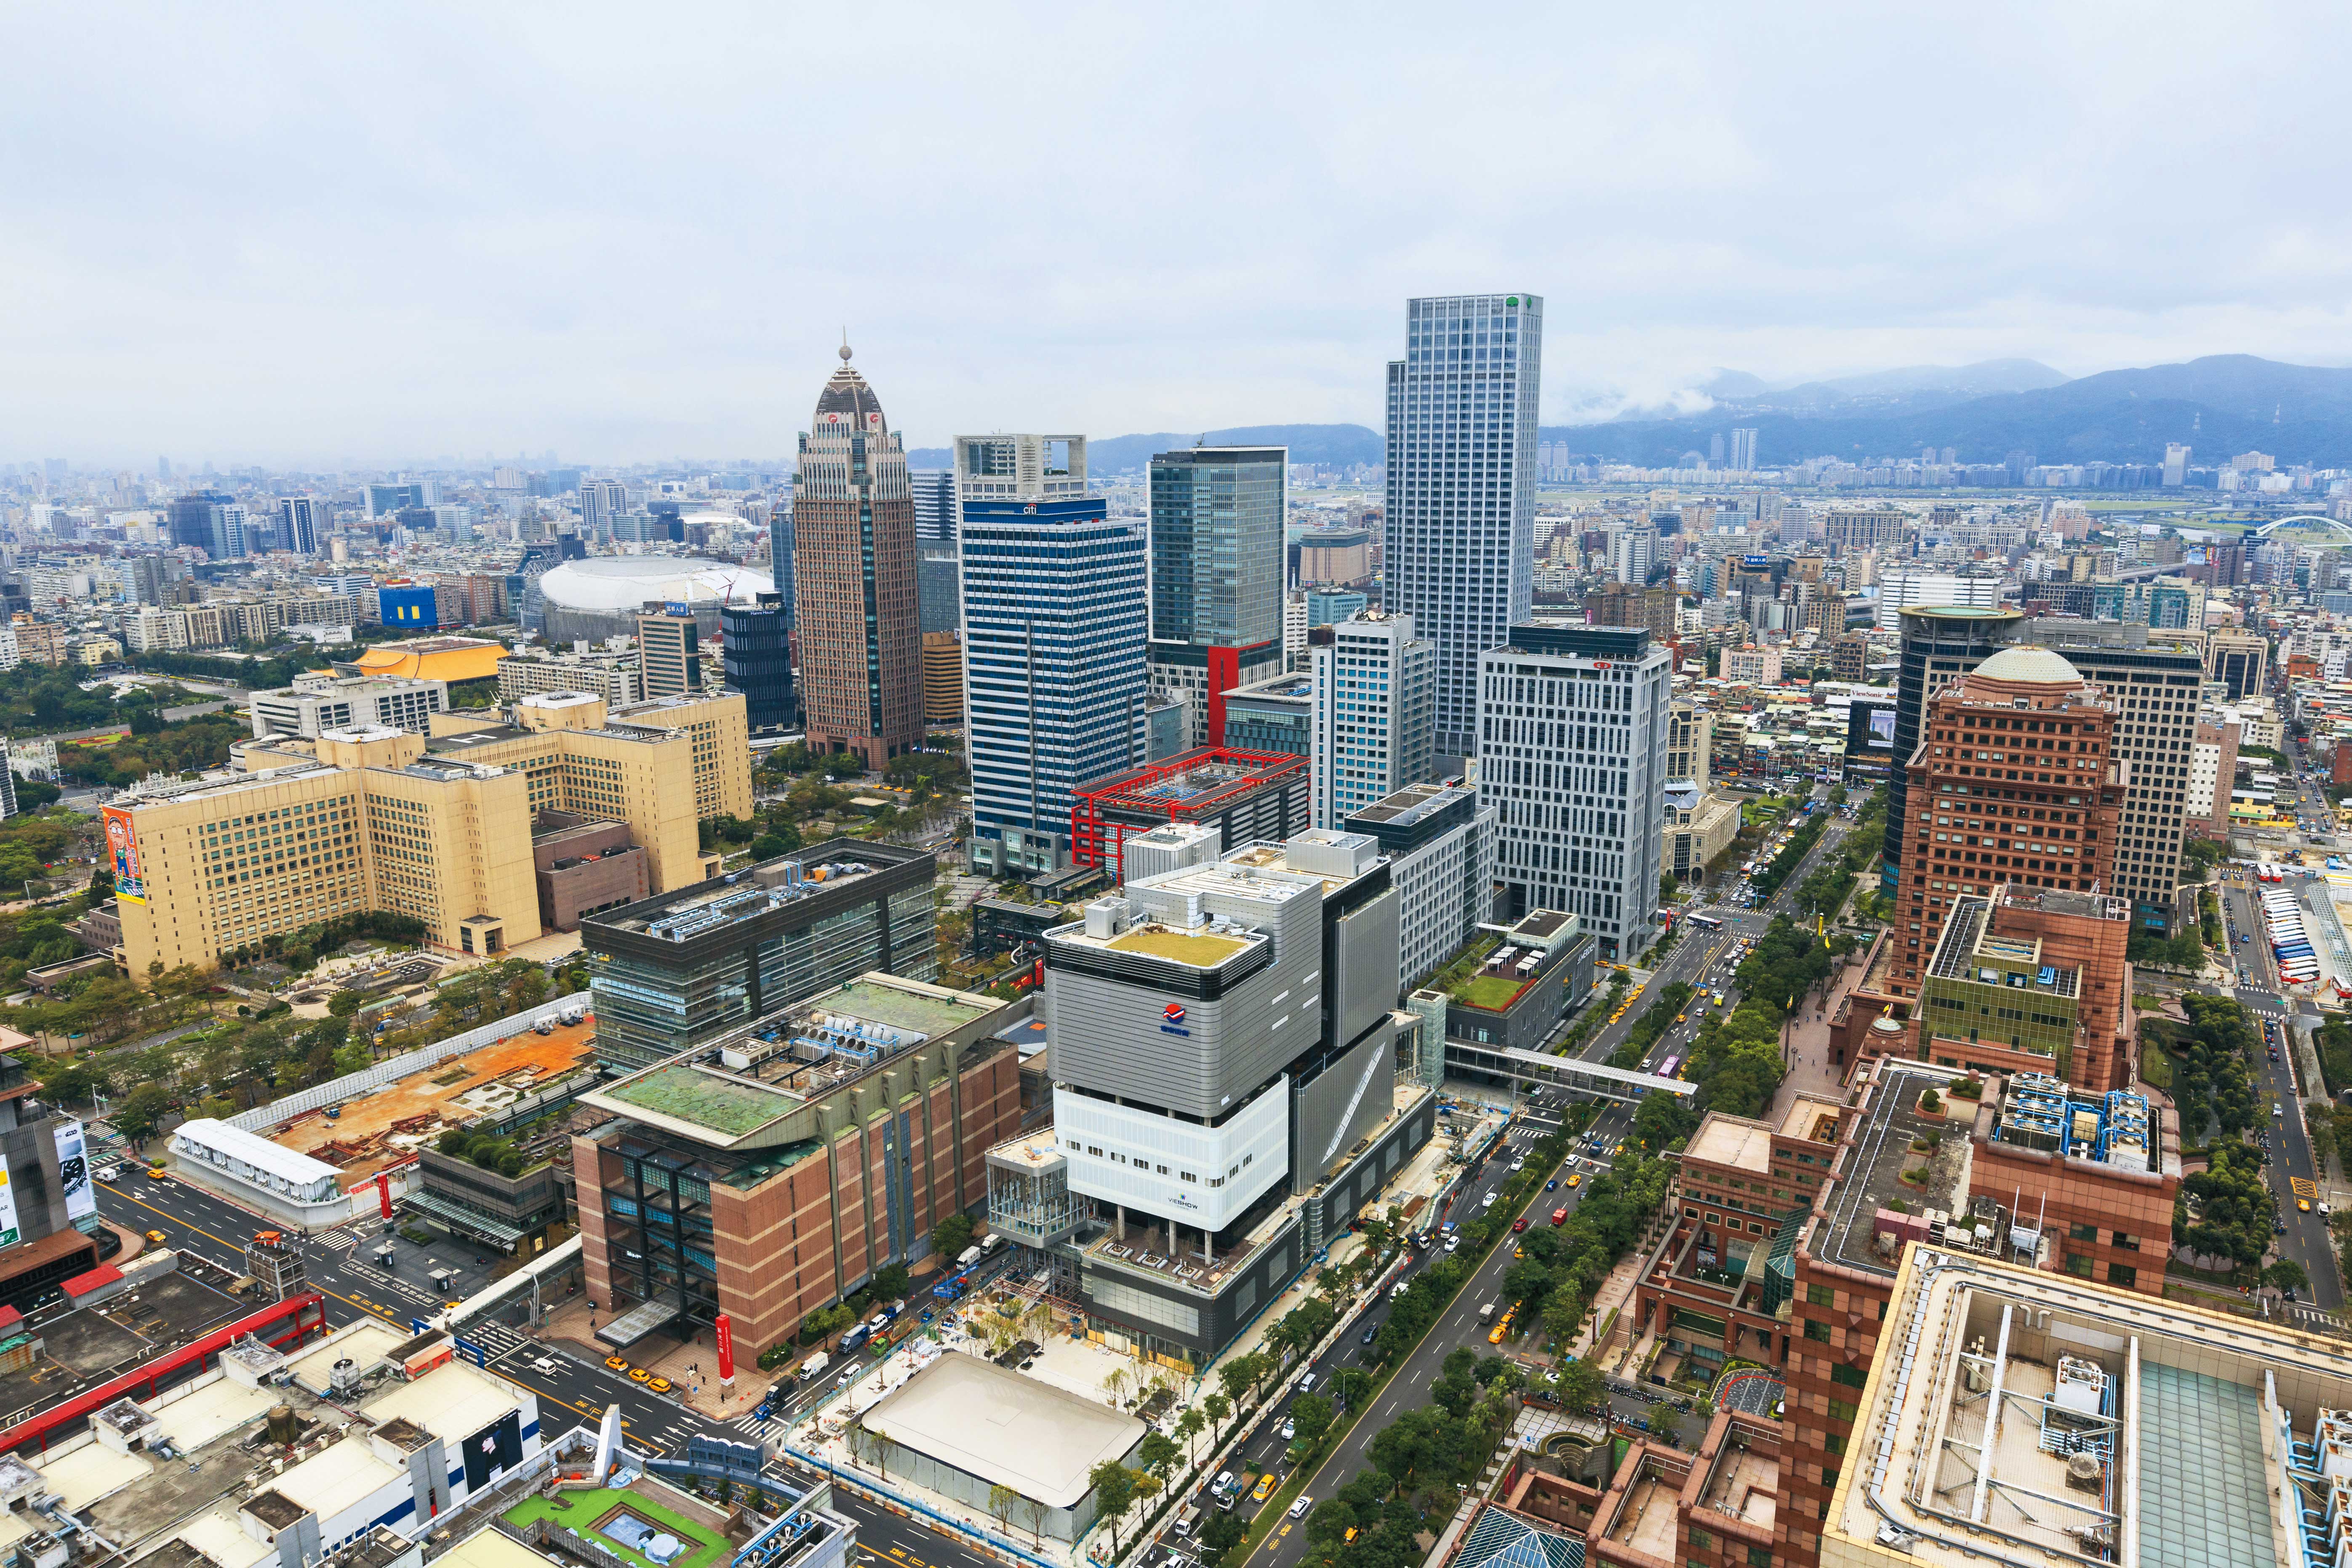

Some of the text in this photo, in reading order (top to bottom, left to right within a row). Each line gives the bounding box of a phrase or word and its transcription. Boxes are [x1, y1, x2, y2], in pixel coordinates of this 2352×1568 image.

[1023, 504, 1037, 514] citi
[1852, 690, 1883, 699] ViewSonic
[1168, 1197, 1198, 1209] VIESHOW
